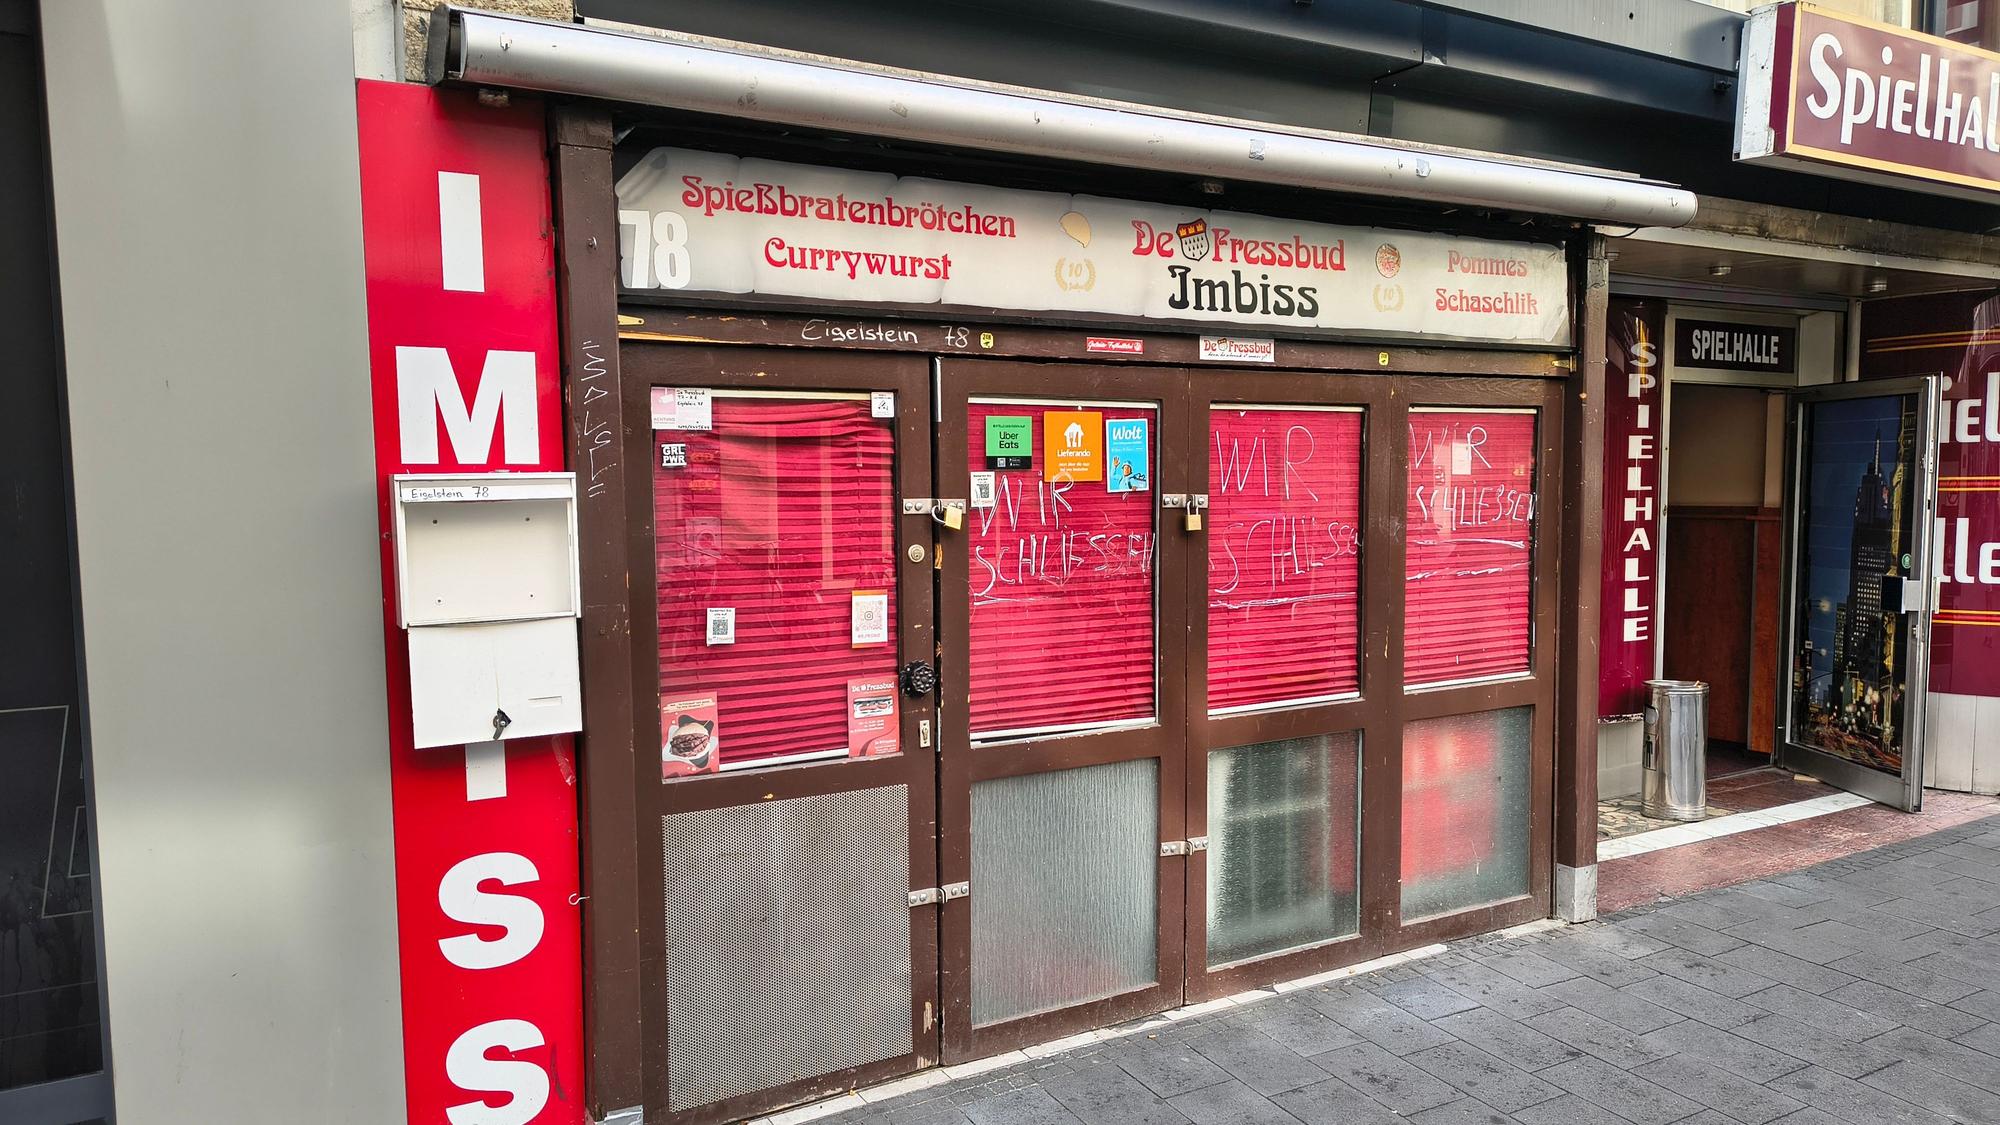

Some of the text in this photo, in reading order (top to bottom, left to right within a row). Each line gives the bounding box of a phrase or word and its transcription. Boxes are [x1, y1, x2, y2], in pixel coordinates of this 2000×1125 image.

[682, 174, 1017, 238] Spießbratenbrötchen
[619, 209, 691, 289] 78
[764, 236, 952, 281] Currywurst
[1131, 218, 1346, 272] De Fressbud
[1446, 249, 1528, 278] Pommes
[1435, 287, 1539, 316] Schaschlik
[801, 318, 970, 348] Eigelstein 78
[1203, 339, 1272, 355] De Fressbud
[1691, 328, 1779, 365] SPIELHALLE
[999, 431, 1019, 440] Uber
[999, 440, 1019, 449] Eats
[1112, 426, 1143, 441] Wolt
[662, 445, 686, 456] GRL
[662, 455, 687, 465] PWR
[1056, 449, 1091, 458] Lieferando
[411, 486, 489, 500] Eigelstein 78
[1623, 342, 1657, 642] SPIELHALLE
